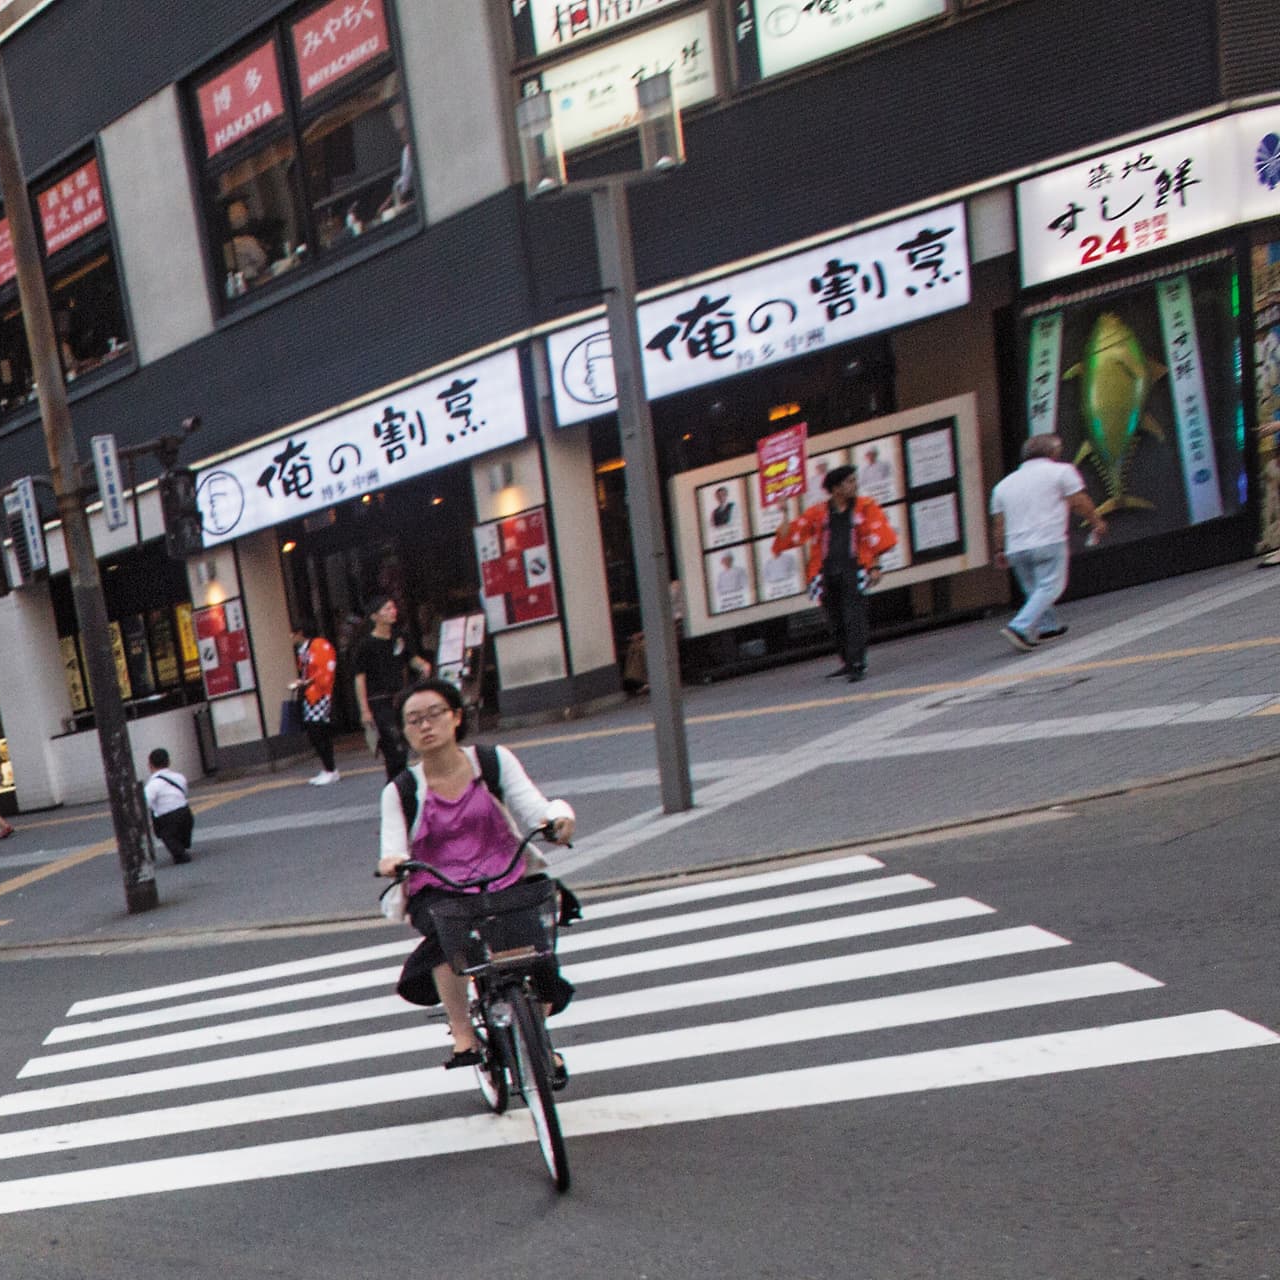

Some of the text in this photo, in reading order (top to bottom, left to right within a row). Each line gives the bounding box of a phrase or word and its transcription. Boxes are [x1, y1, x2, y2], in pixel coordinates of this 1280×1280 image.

[303, 0, 374, 57] みやちく
[213, 67, 262, 116] 博多
[214, 100, 273, 148] HAKATA
[1087, 152, 1160, 190] 築地
[1046, 157, 1202, 240] すし鮮
[1080, 226, 1129, 265] 24
[646, 226, 963, 361] 俺の割烹
[258, 379, 487, 499] 俺の割烹
